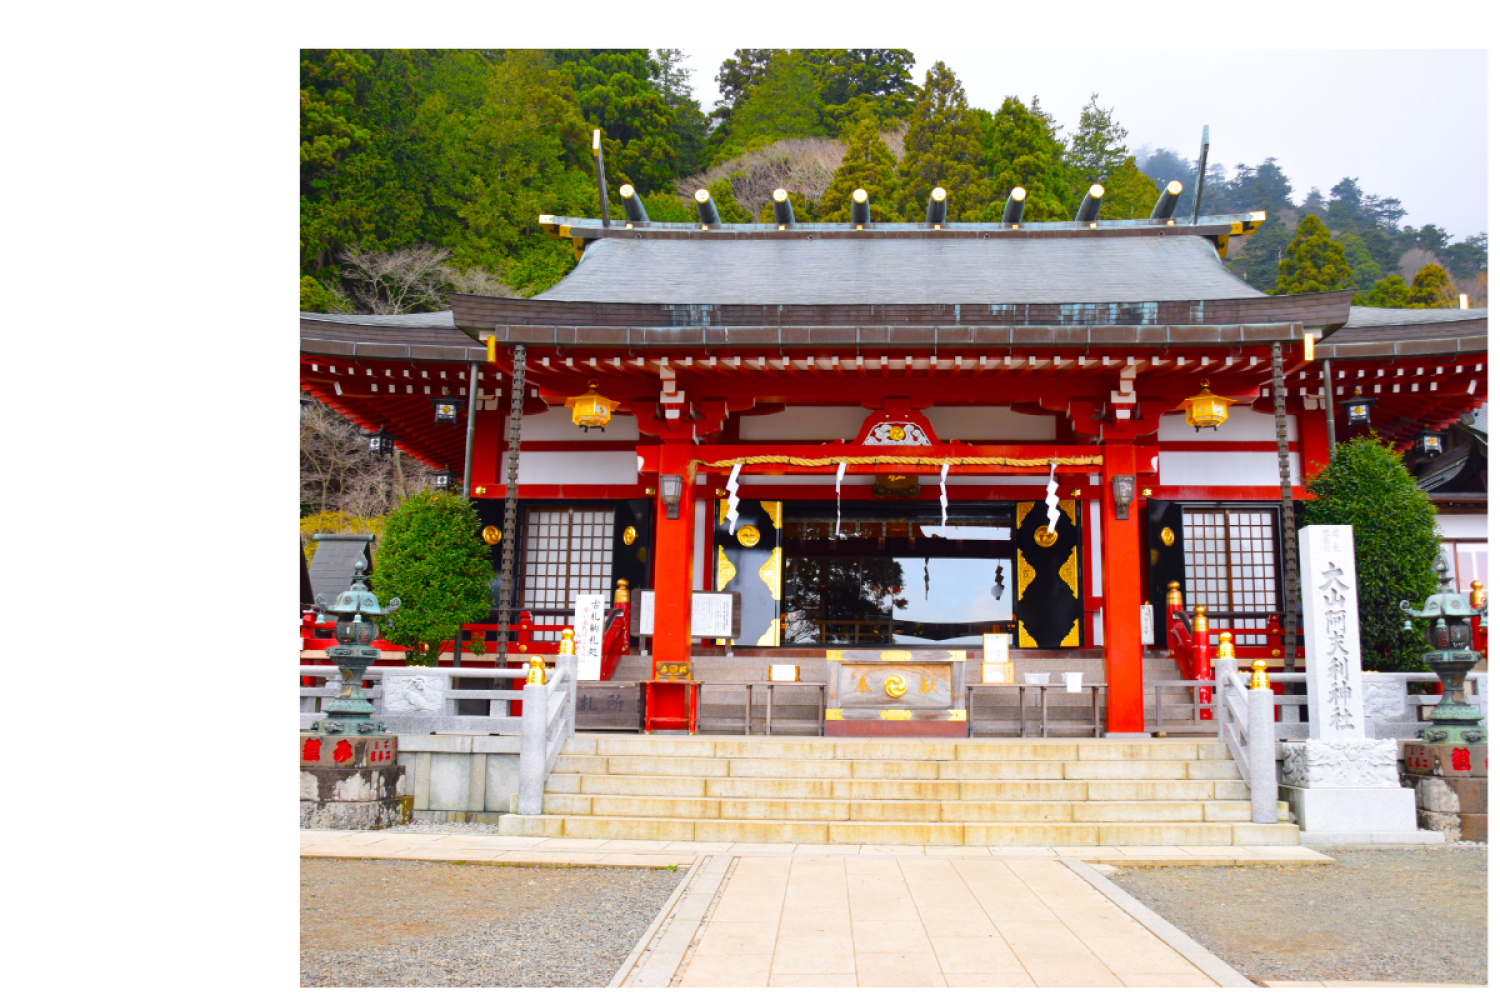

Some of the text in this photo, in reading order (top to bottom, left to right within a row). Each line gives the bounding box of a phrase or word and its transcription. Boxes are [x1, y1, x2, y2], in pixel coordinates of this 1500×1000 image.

[587, 599, 601, 657] 古札納札処
[1318, 561, 1355, 731] 大山阿夫利神社
[854, 675, 940, 695] 奉 献
